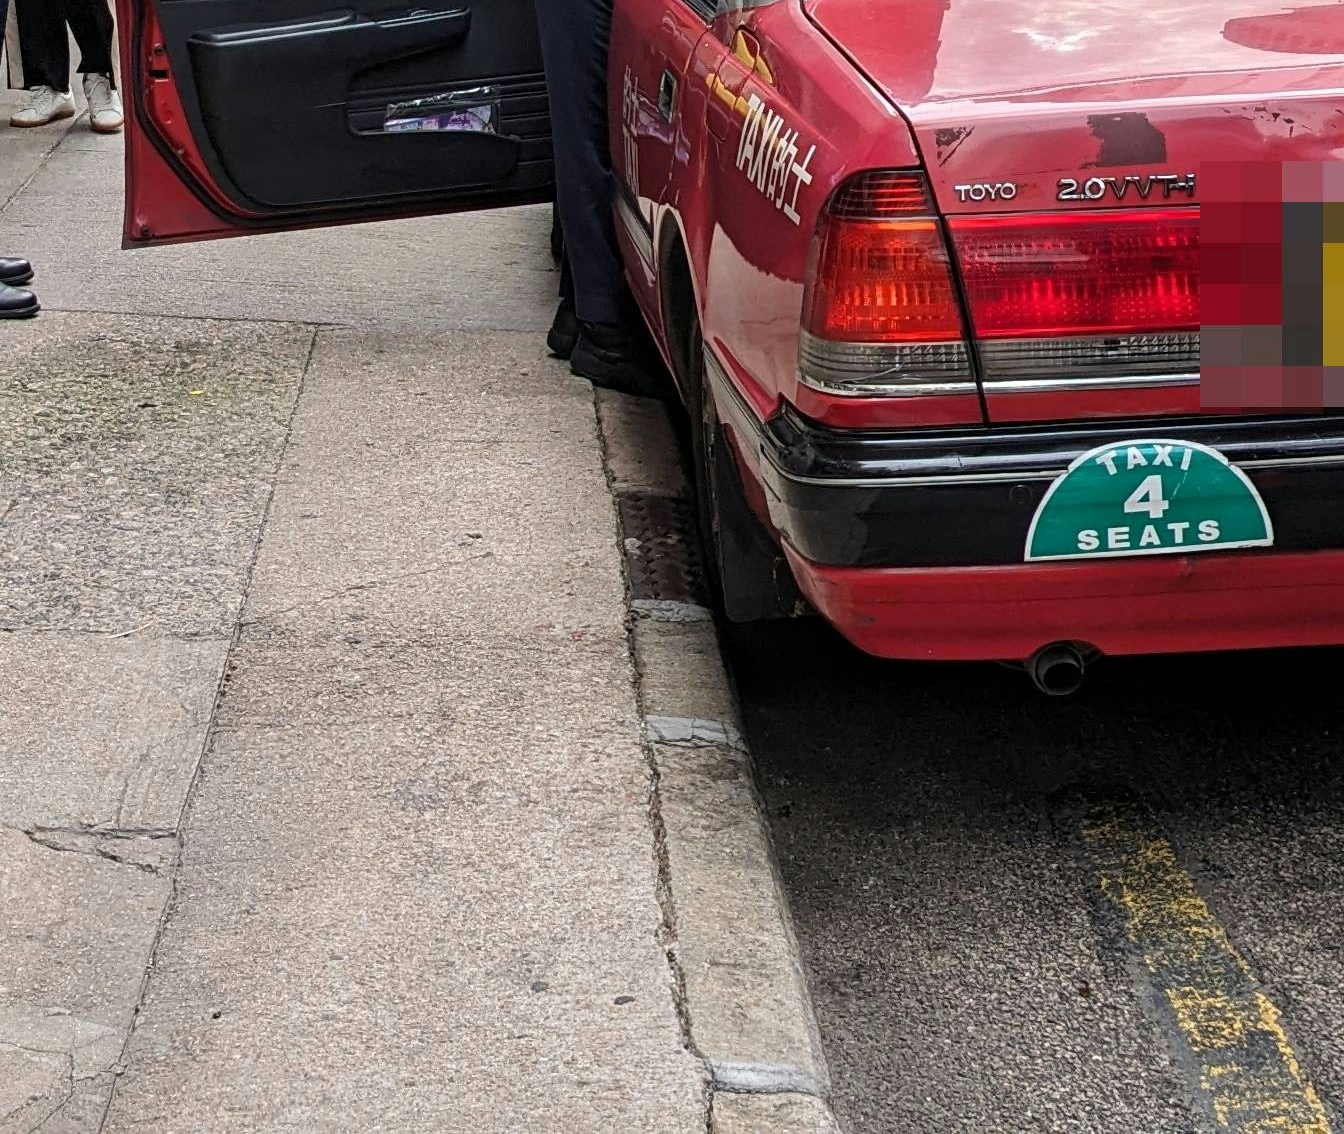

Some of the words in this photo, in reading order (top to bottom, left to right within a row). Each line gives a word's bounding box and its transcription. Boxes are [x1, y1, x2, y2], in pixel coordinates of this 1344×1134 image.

[955, 183, 1017, 202] TOYO
[1095, 444, 1193, 476] TAXI
[1123, 474, 1170, 519] 4
[1076, 519, 1221, 551] SEATS
